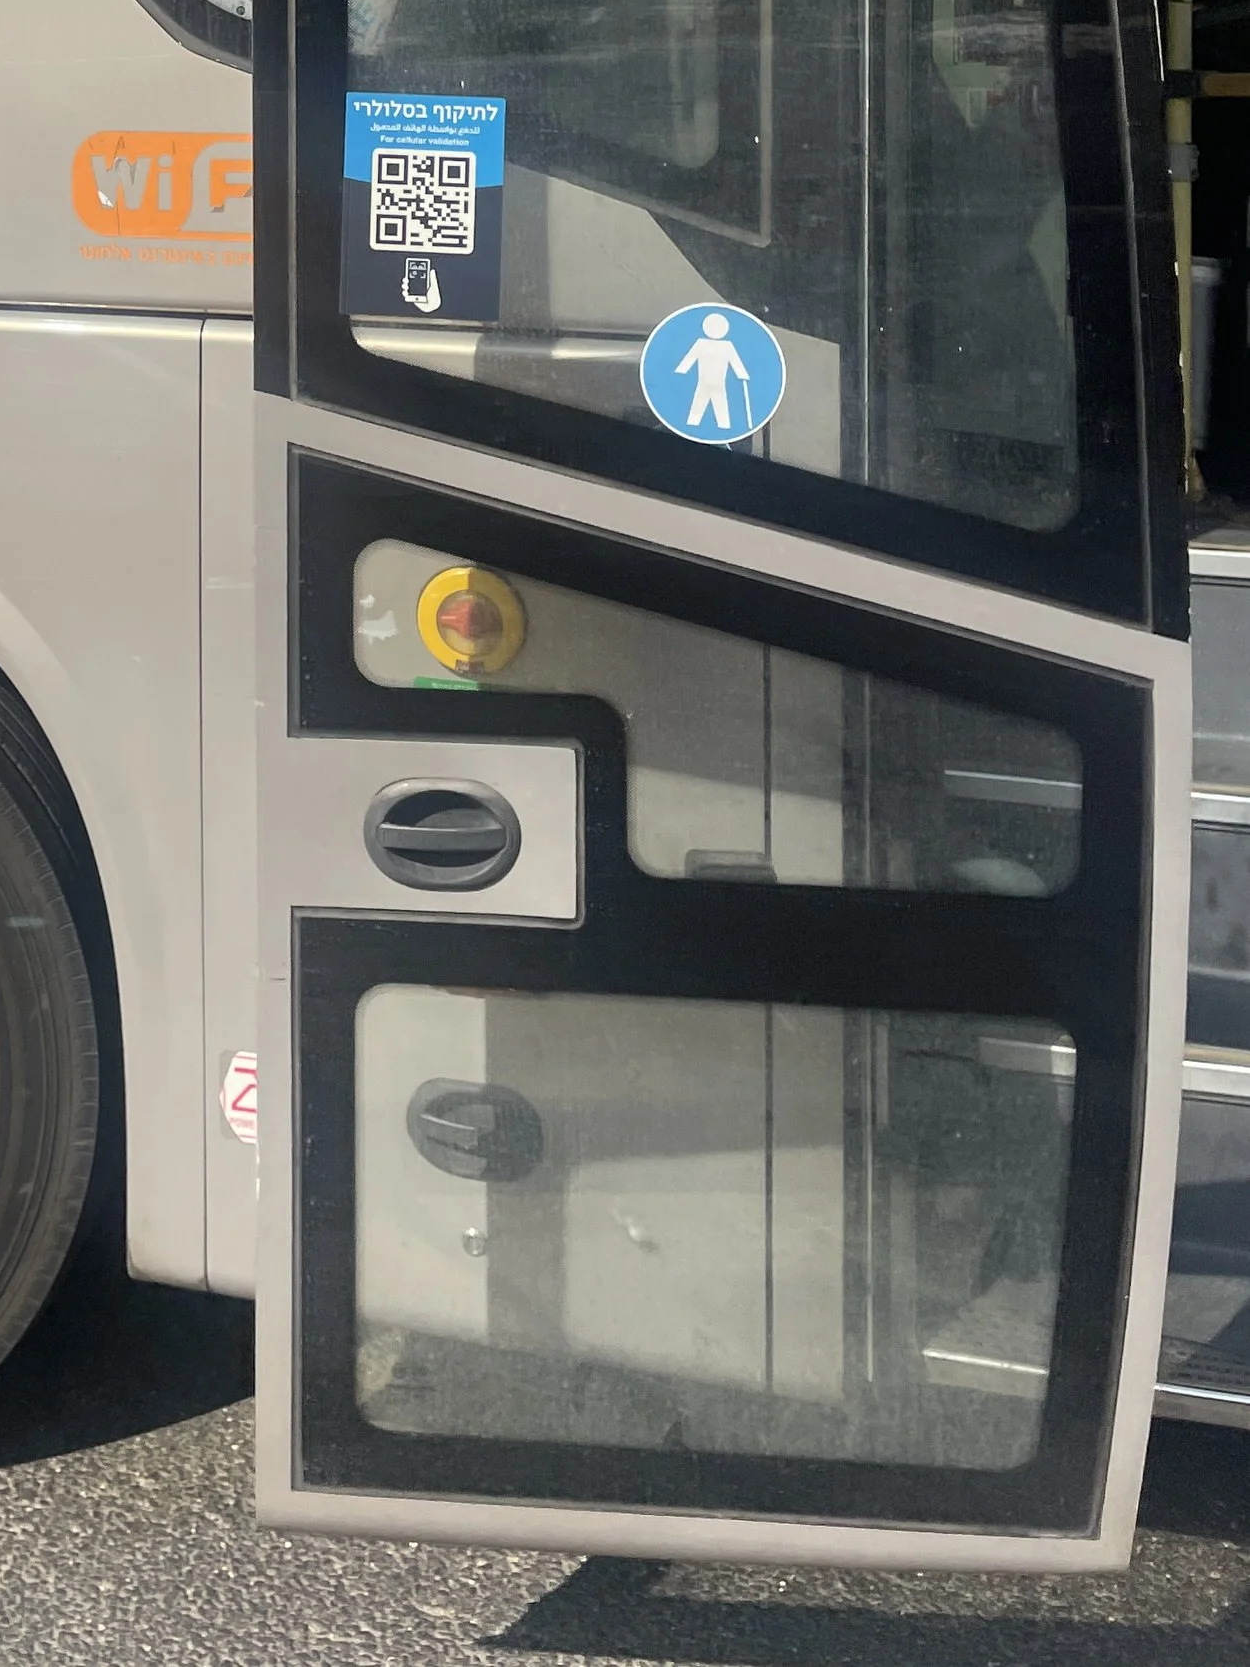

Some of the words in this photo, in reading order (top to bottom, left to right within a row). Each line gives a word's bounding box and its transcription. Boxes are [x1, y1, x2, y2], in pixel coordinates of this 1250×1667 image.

[353, 99, 428, 119] בסלולרי
[433, 104, 499, 124] לתיקוף
[380, 135, 394, 143] For
[396, 136, 427, 145] cellular
[428, 138, 470, 146] validation
[90, 154, 253, 212] WiF
